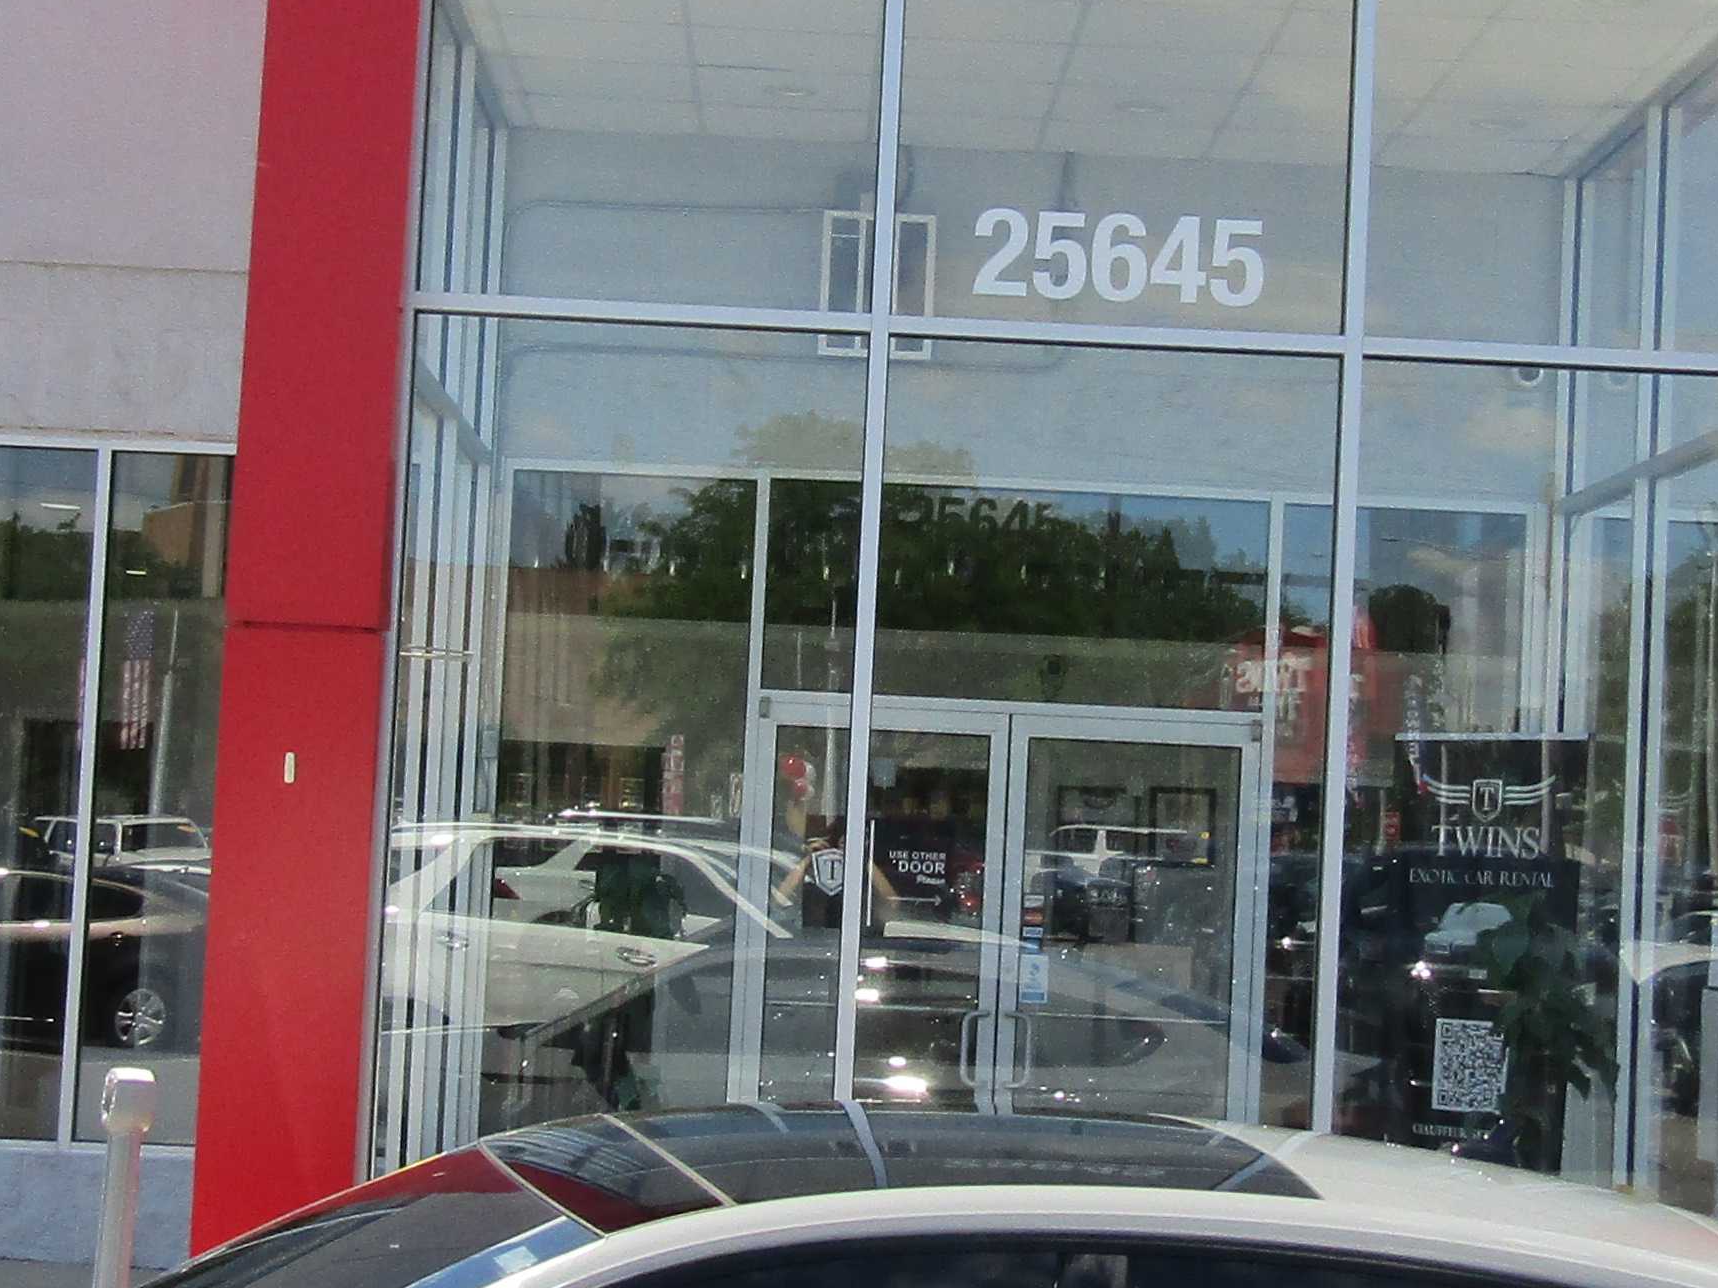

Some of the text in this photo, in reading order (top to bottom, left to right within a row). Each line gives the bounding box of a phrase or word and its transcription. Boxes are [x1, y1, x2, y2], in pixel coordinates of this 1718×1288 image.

[971, 208, 1266, 307] 25645
[1480, 786, 1496, 811] T
[1431, 825, 1541, 860] TWINS
[889, 850, 947, 861] USE OTHER
[898, 860, 945, 875] DOOR
[1409, 868, 1555, 888] EXOTIC CAR RENTAL
